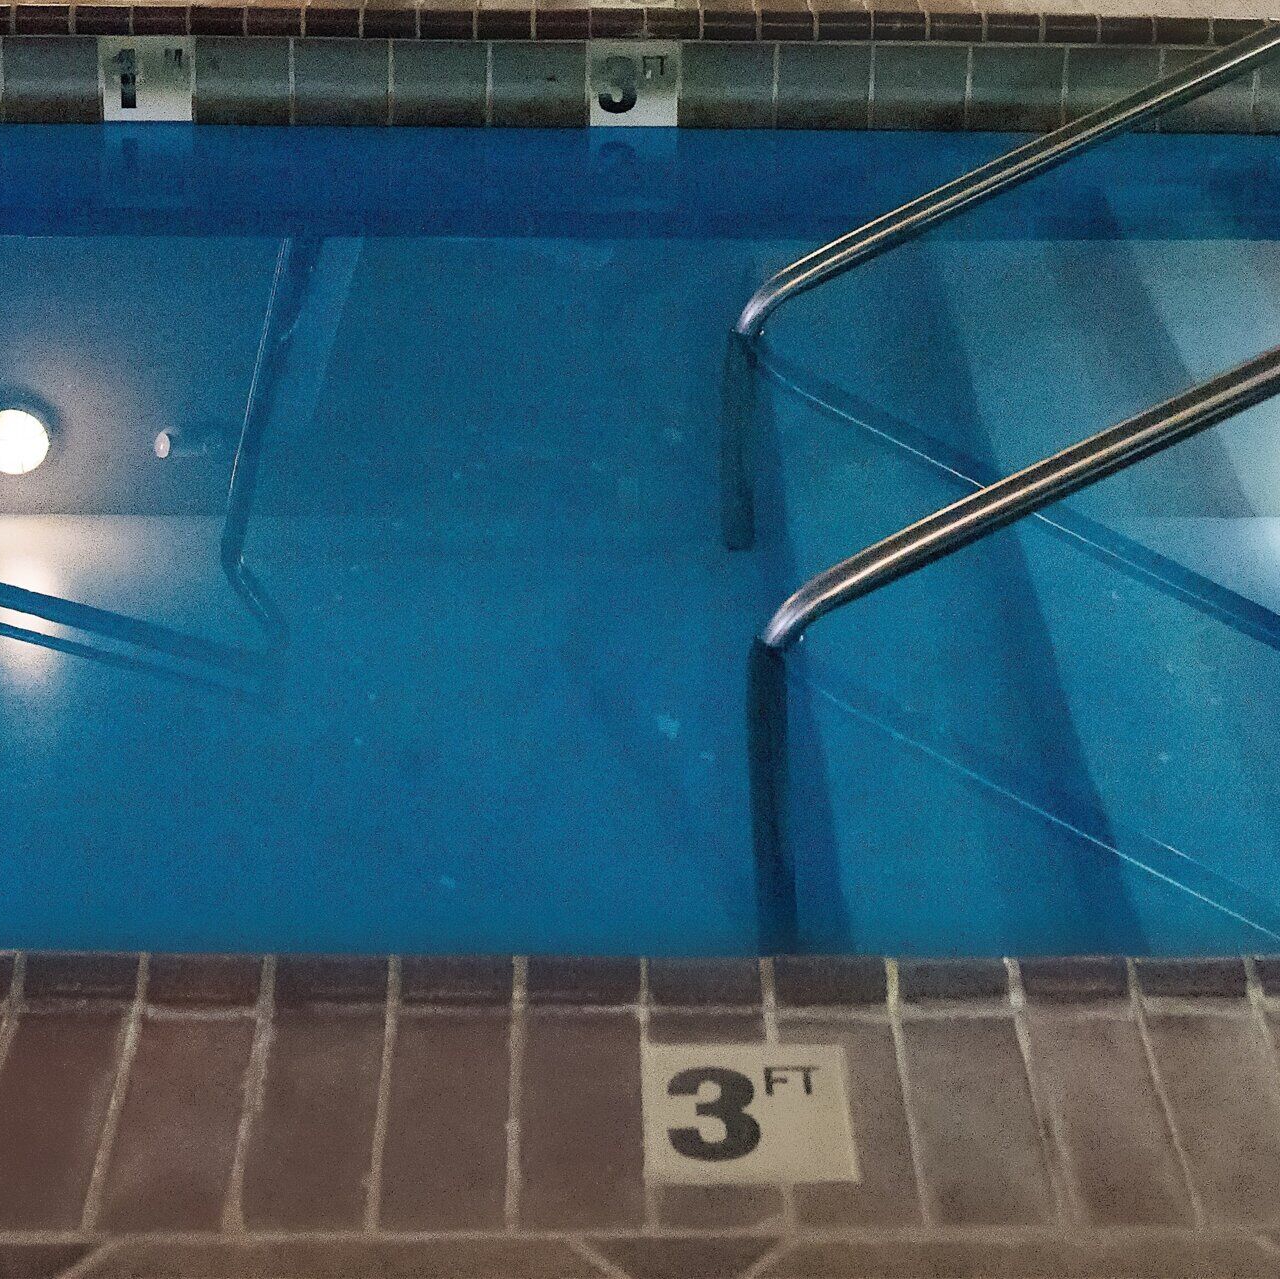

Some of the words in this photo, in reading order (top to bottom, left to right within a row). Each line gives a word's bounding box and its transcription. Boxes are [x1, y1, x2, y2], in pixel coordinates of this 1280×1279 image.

[111, 48, 136, 108] 1
[598, 54, 638, 114] 3
[666, 1066, 761, 1161] 3
[763, 1065, 819, 1097] FT
